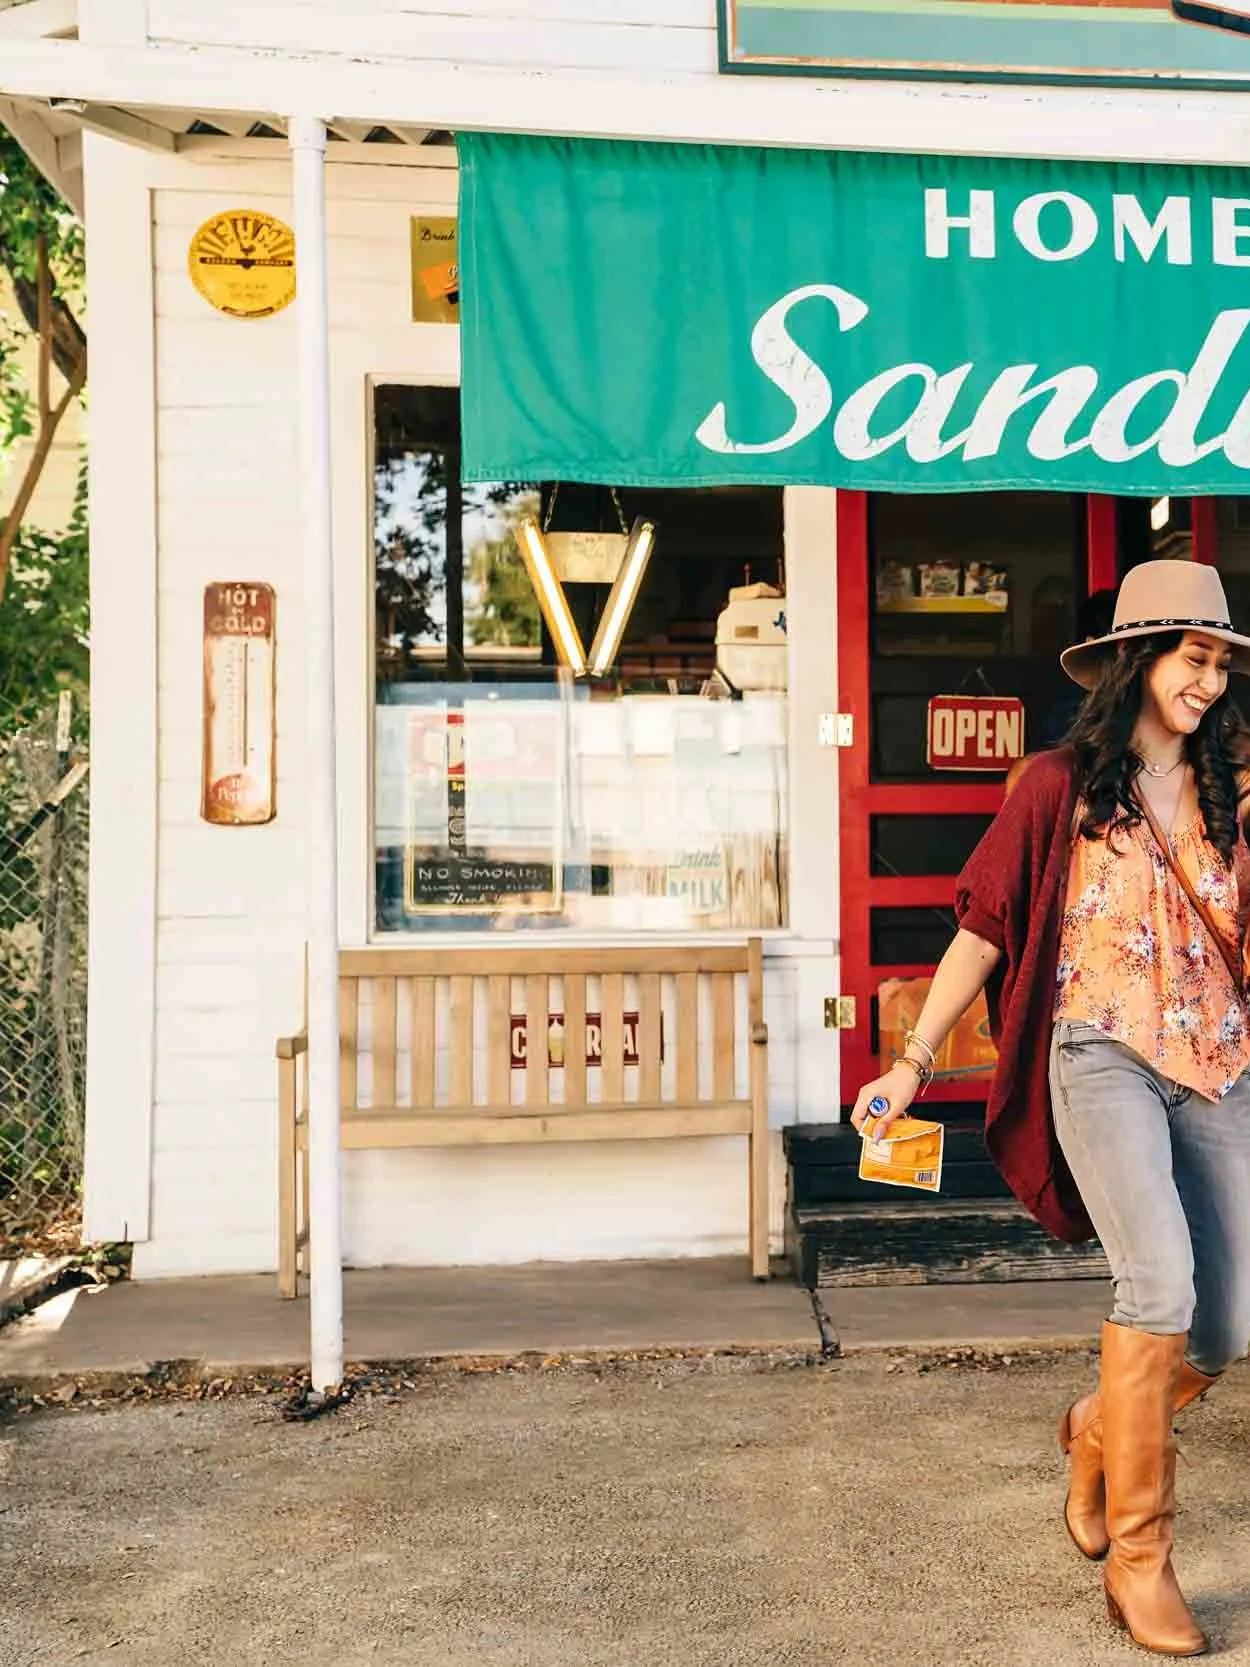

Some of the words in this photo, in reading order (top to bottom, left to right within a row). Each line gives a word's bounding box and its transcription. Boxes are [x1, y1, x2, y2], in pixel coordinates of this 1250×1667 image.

[211, 216, 283, 246] SUN
[218, 589, 259, 607] HOT
[209, 615, 266, 633] COLD
[933, 708, 1019, 758] OPEN
[418, 867, 449, 881] NO
